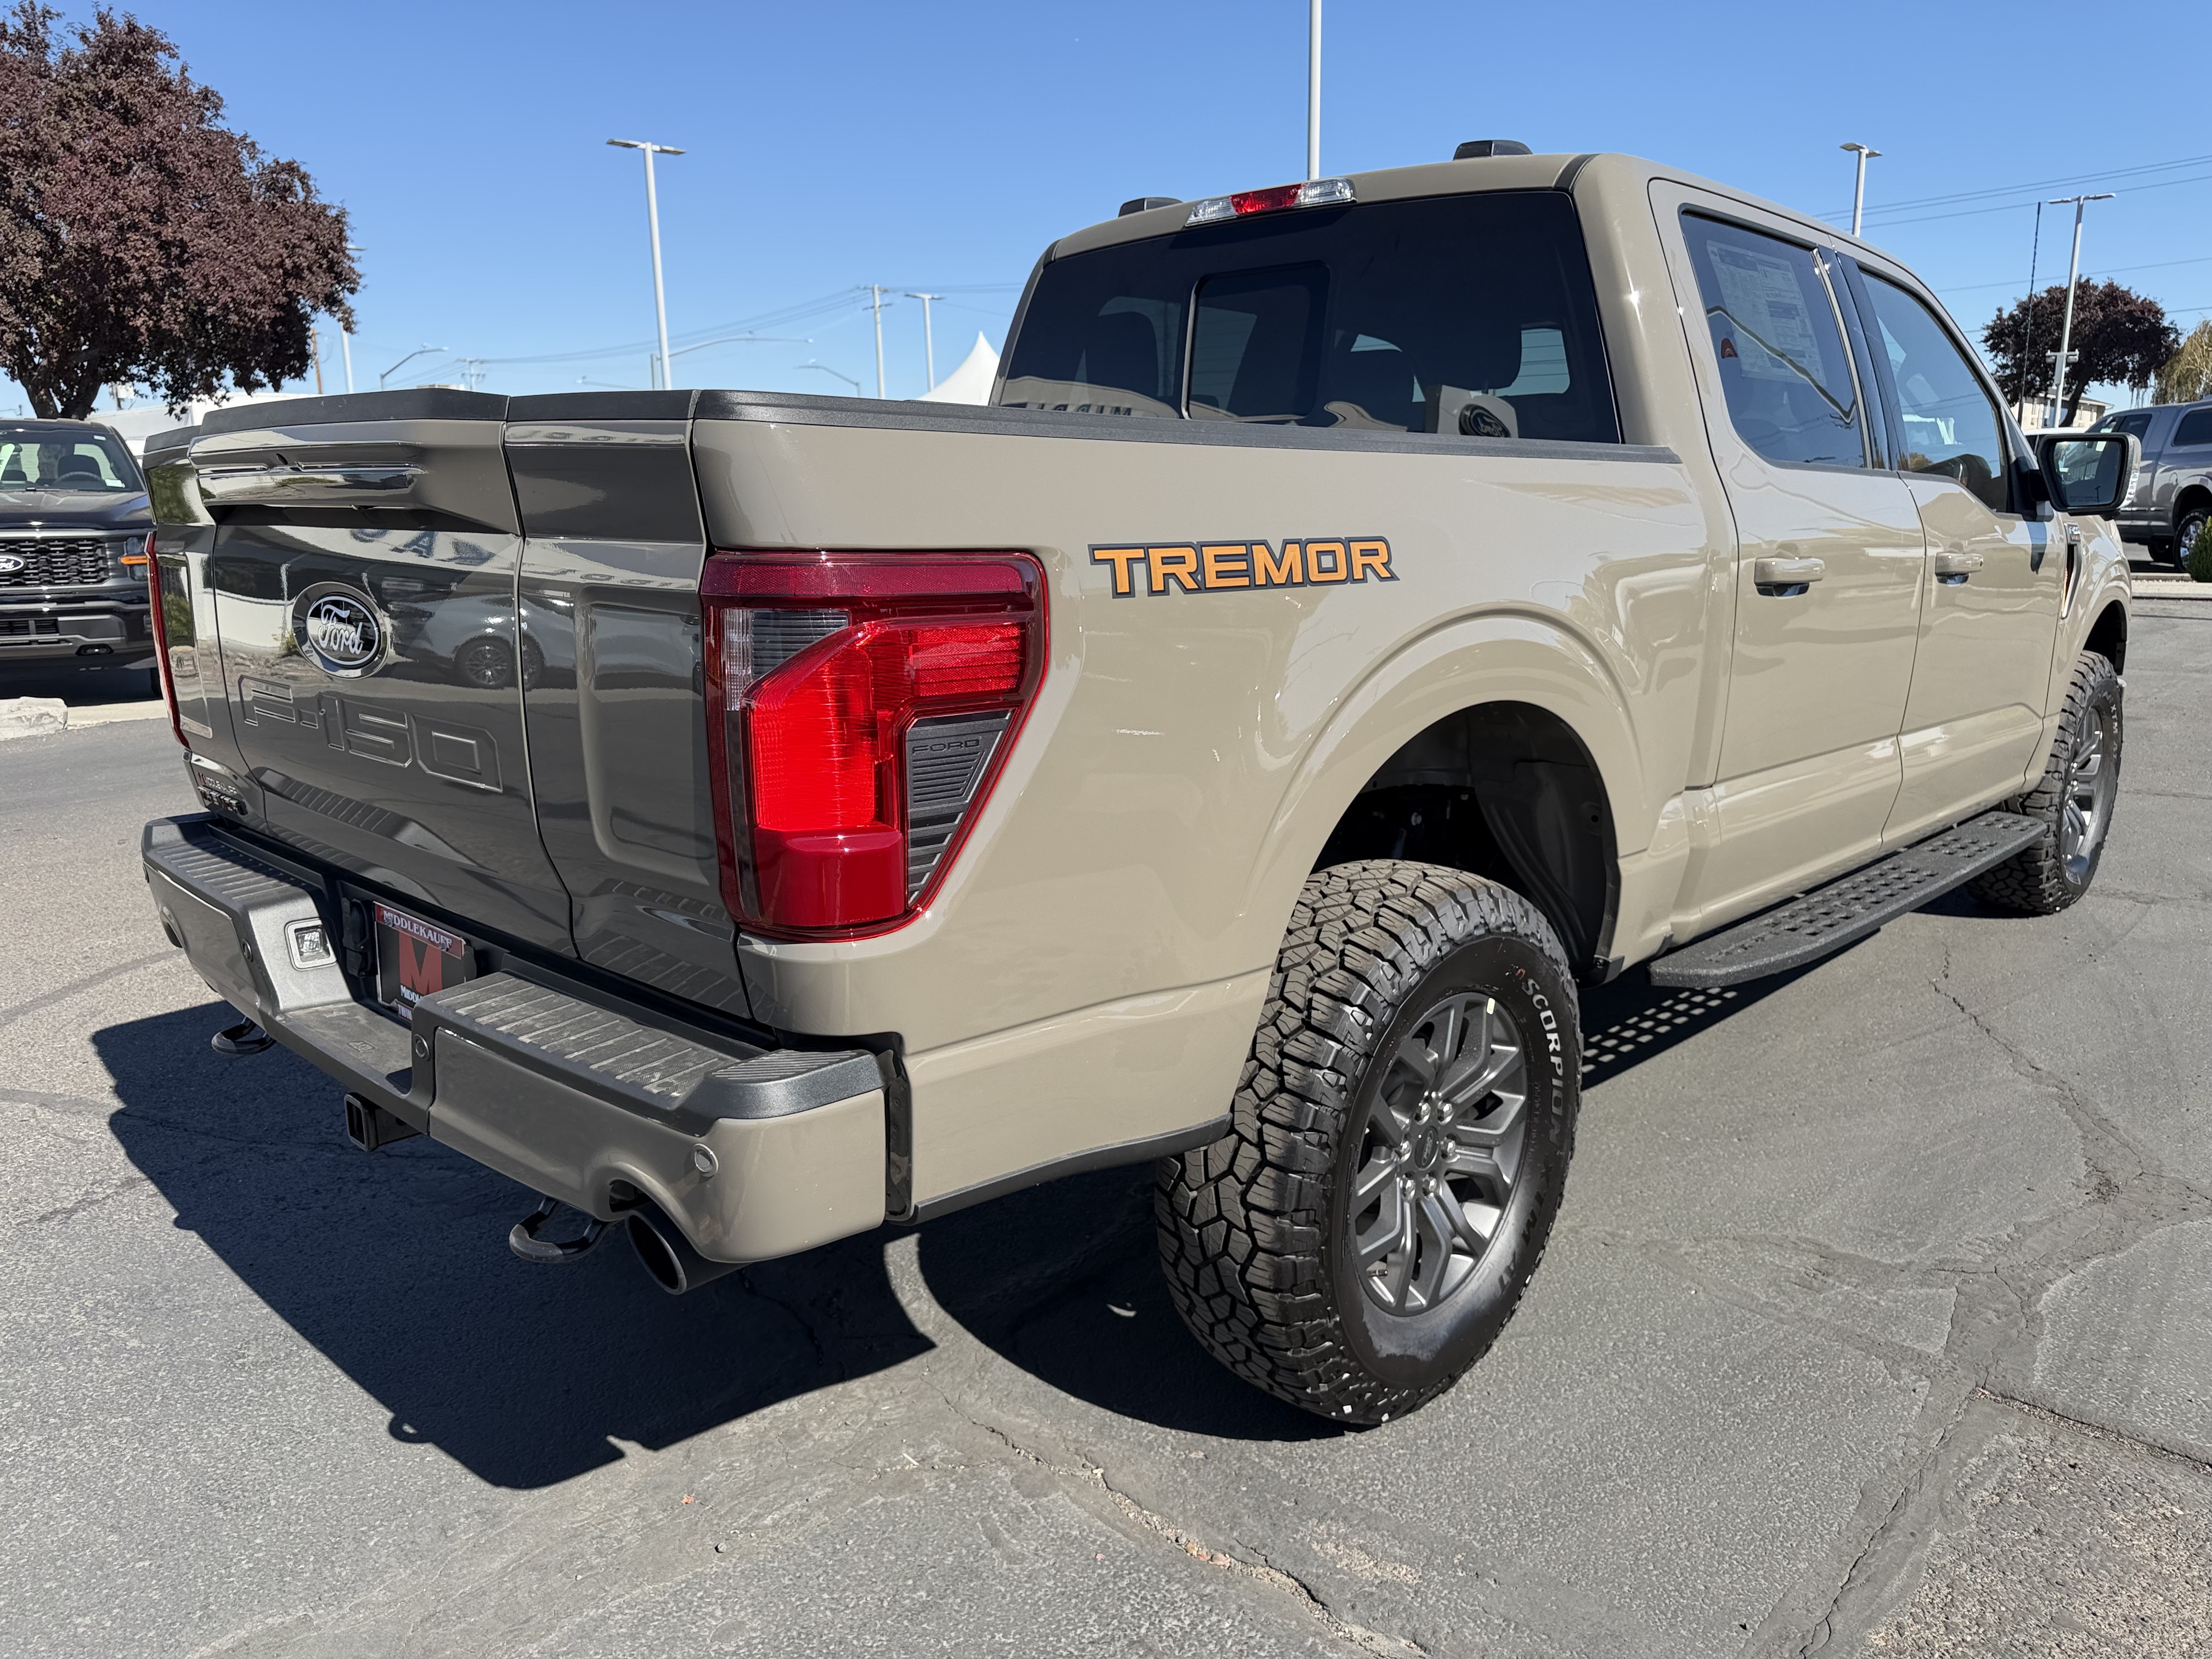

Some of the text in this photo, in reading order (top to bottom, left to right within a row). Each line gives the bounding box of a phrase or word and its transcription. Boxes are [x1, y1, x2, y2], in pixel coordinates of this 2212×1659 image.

[1088, 536, 1400, 599] TREMOR
[318, 604, 363, 655] Ford
[238, 675, 503, 793] F-150
[912, 739, 980, 755] FORD
[1521, 978, 1564, 1147] SCORPION
